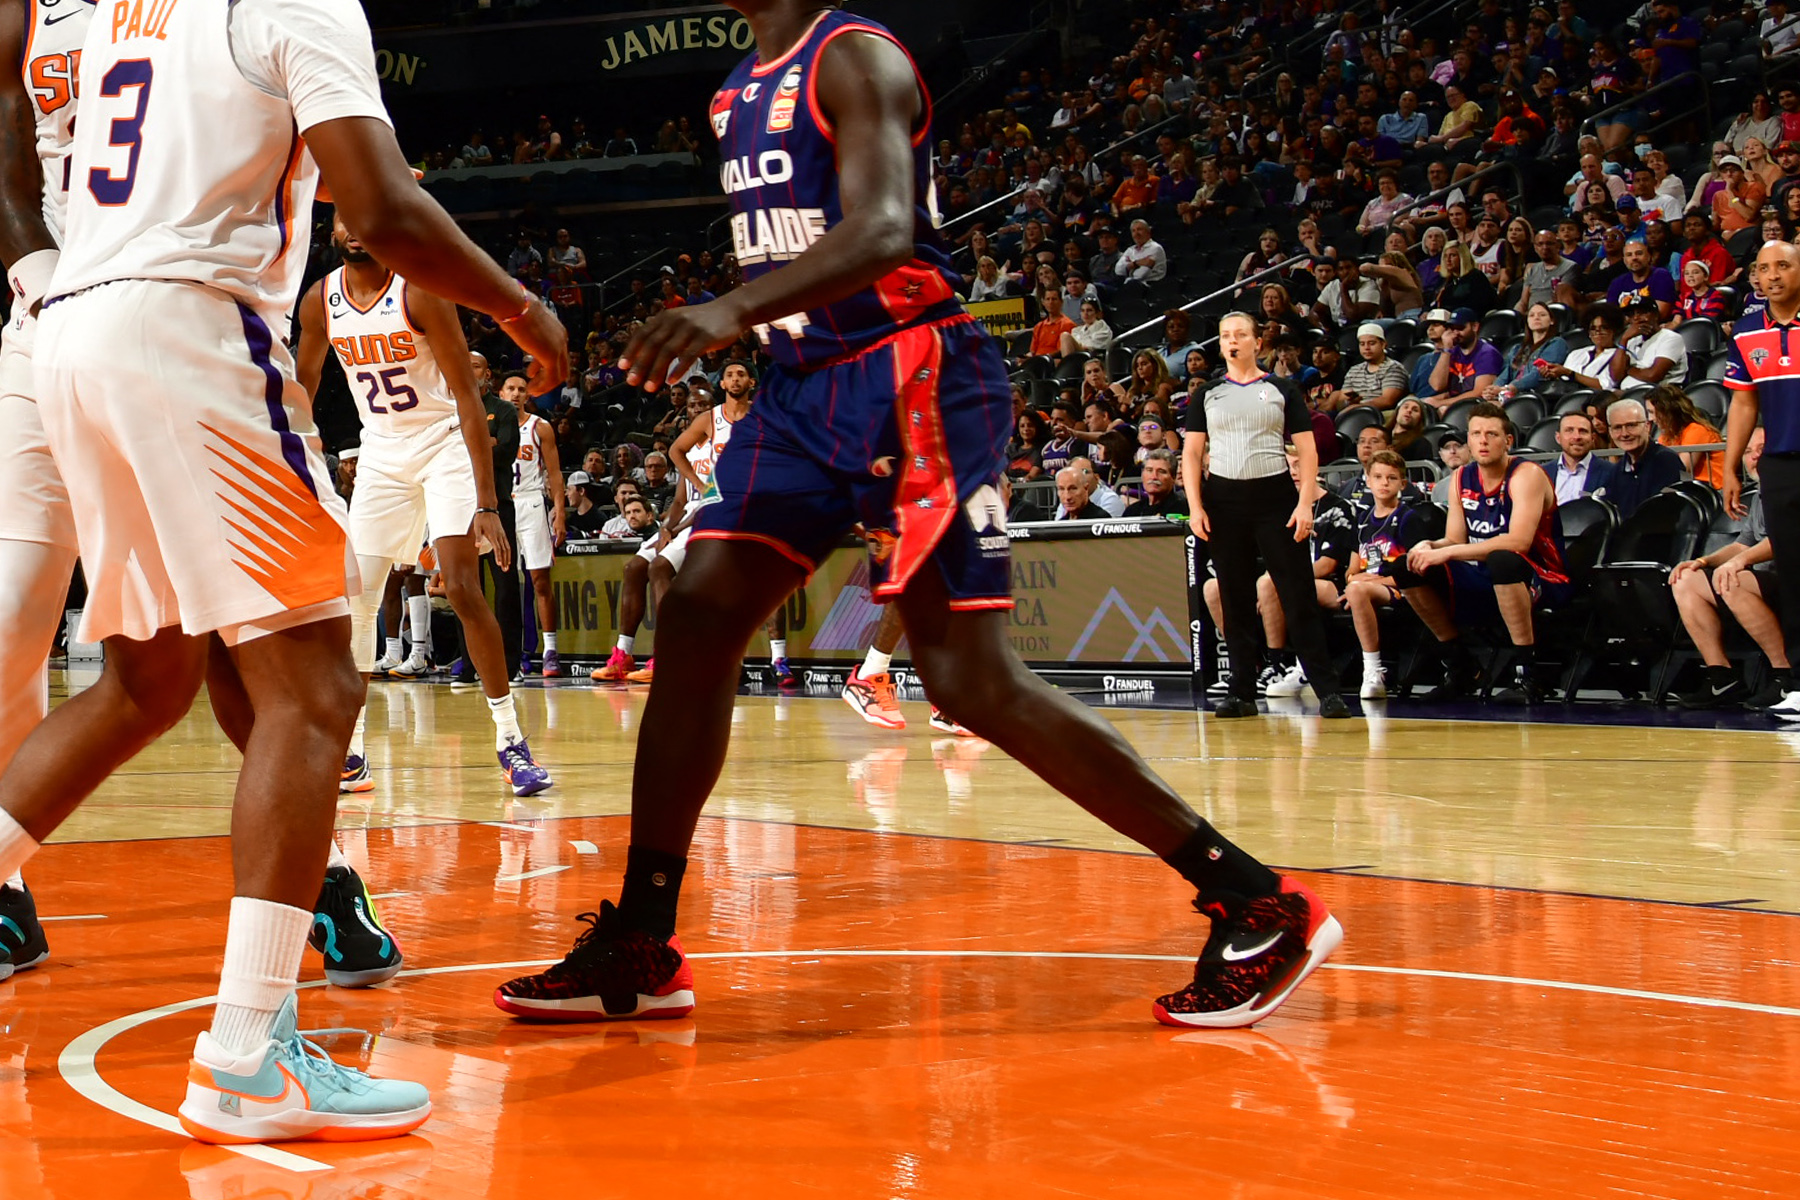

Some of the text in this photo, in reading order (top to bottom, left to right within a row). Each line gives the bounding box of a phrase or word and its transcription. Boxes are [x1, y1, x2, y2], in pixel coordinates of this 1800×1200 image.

[601, 16, 755, 71] JAMESO
[87, 57, 153, 206] 3
[332, 330, 418, 366] SUNS
[356, 366, 419, 414] 25
[1103, 523, 1143, 535] FANDUEL
[1187, 548, 1196, 588] FANDUEL
[1191, 633, 1200, 672] FANDUEL
[1115, 678, 1155, 691] FANDUEL
